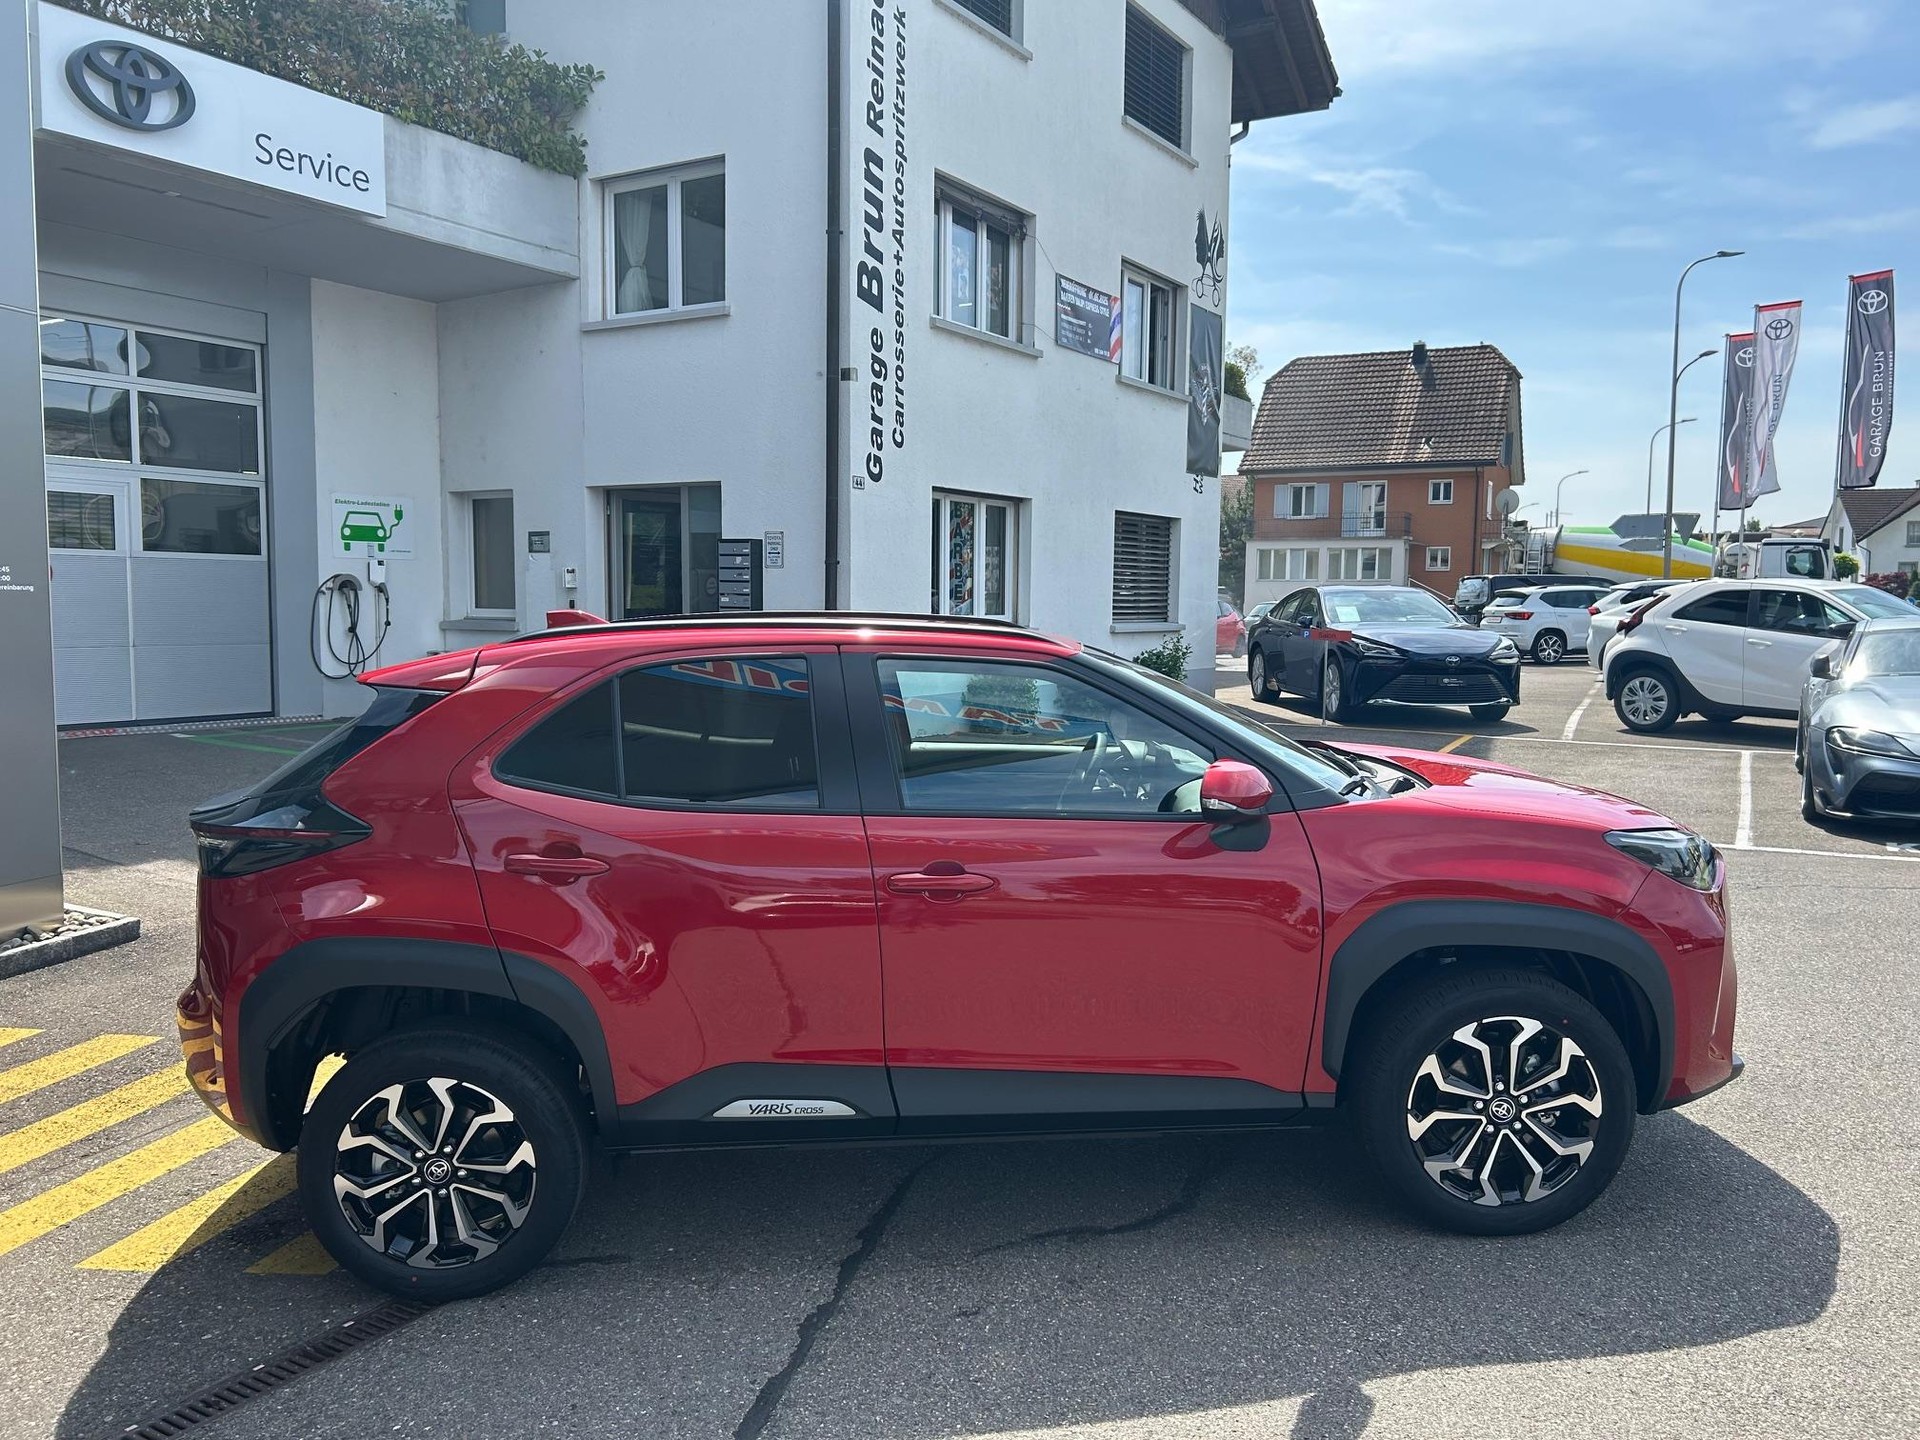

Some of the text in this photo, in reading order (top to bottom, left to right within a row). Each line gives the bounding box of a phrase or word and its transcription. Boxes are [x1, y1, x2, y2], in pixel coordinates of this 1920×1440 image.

[255, 133, 370, 192] Service
[857, 147, 884, 313] Brun
[866, 327, 888, 483] Garage
[1869, 351, 1885, 457] GARAGE BRUN
[953, 503, 964, 606] BARBE
[748, 1103, 824, 1115] YARIS CROSS
